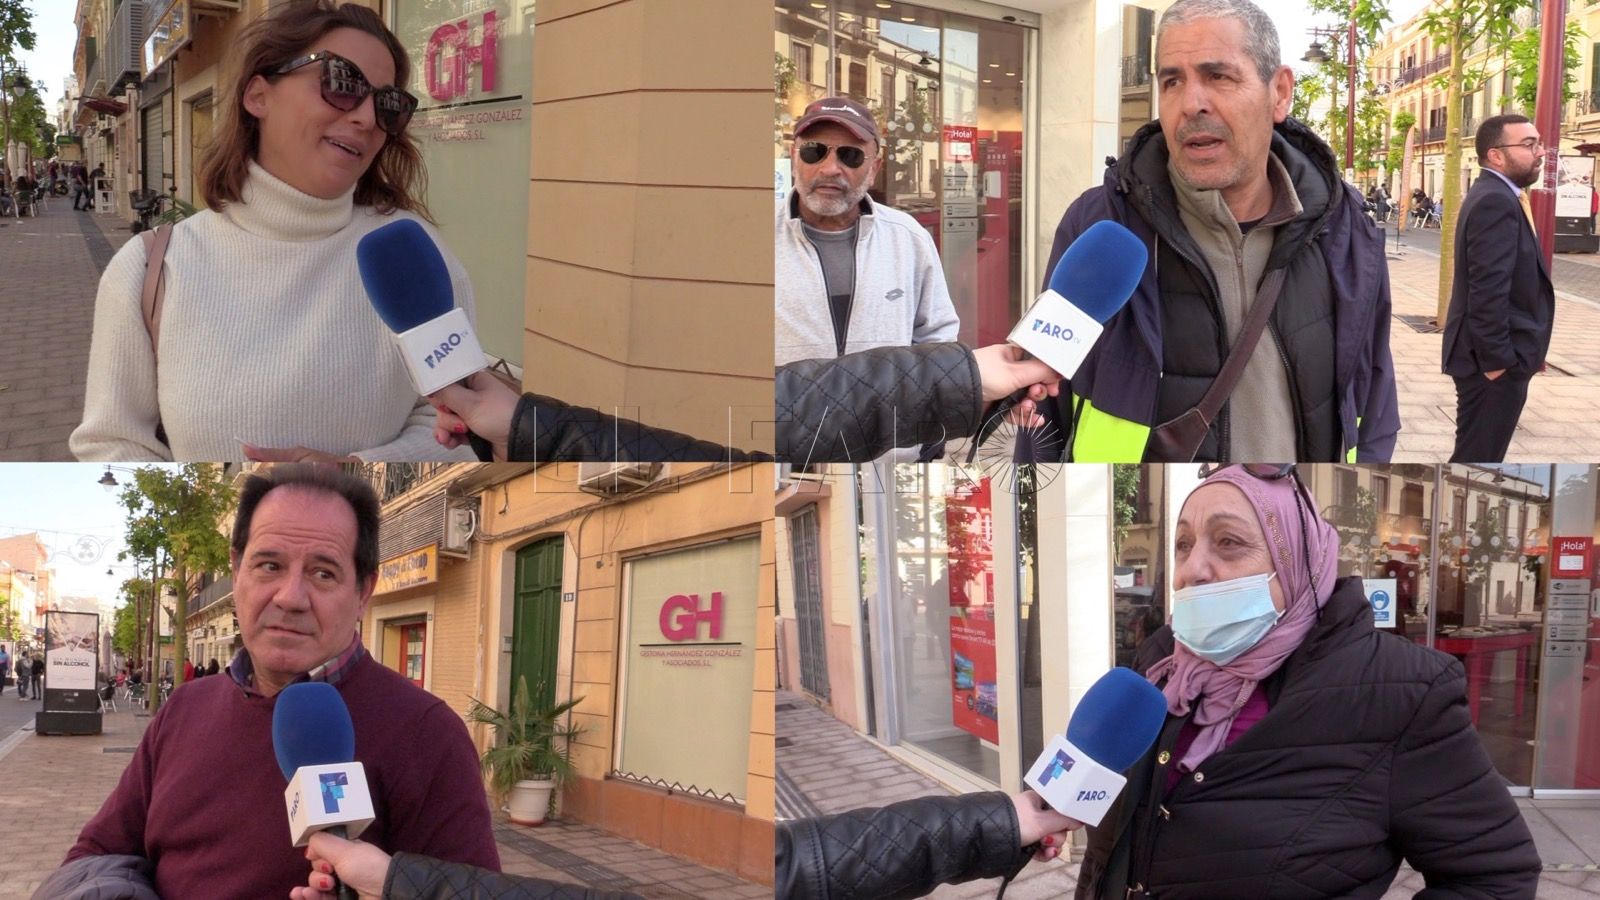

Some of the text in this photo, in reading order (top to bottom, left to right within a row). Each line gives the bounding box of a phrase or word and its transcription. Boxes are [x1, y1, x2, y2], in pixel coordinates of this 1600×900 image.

[424, 10, 497, 101] GH
[1032, 319, 1074, 341] FARO
[424, 333, 461, 369] FARO
[1560, 542, 1586, 552] ¡Hola!
[659, 591, 722, 643] GH
[1077, 790, 1107, 802] FARO
